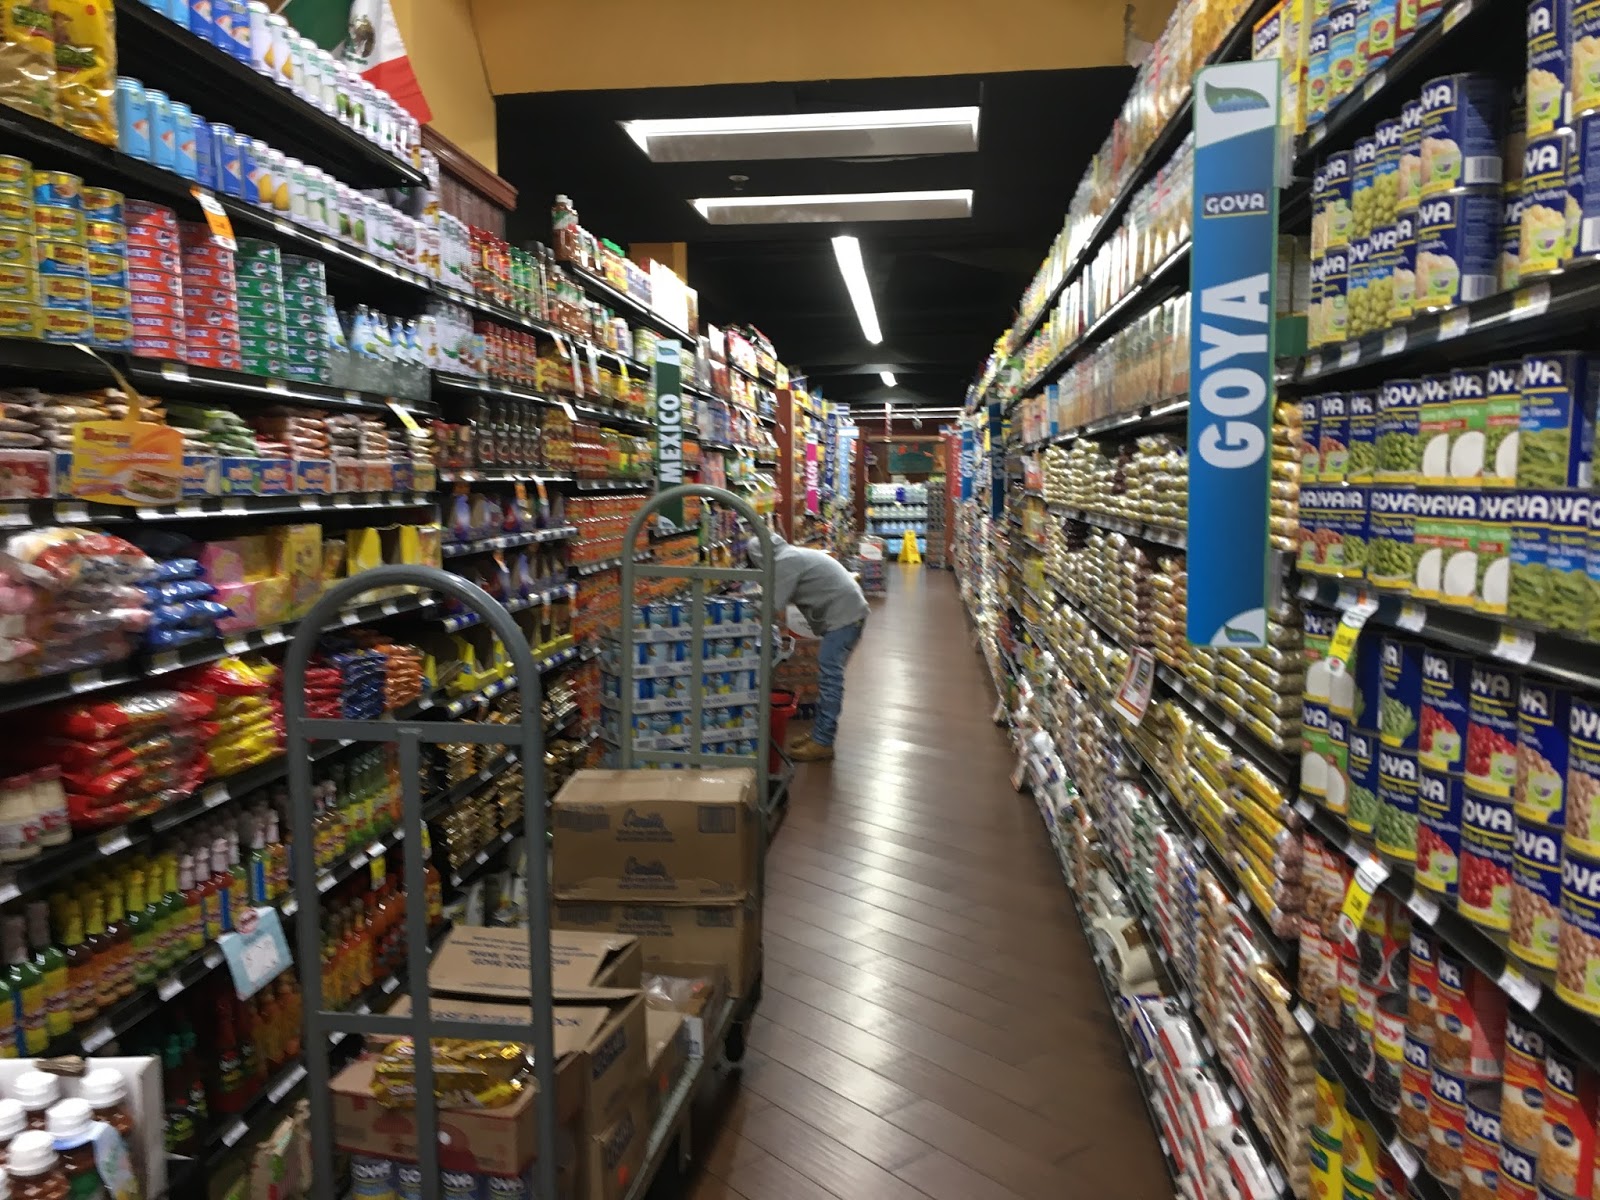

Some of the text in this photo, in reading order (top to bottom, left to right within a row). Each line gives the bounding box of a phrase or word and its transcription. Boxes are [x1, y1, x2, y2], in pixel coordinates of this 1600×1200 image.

[1421, 85, 1452, 110] YA
[1524, 145, 1558, 173] YA
[1206, 193, 1264, 213] GOYA
[1419, 202, 1452, 225] YA
[1370, 231, 1397, 251] YA
[1198, 273, 1269, 469] GOYA
[1523, 360, 1562, 385] YA
[1452, 375, 1483, 396] YA
[658, 393, 682, 483] MEXICO
[805, 460, 818, 491] TACOS
[1423, 655, 1449, 680] YA
[1380, 752, 1417, 780] OYA
[1419, 774, 1445, 802] YA
[1463, 799, 1513, 832] OYA
[1431, 1072, 1463, 1102] YA
[1466, 1104, 1500, 1141] YA
